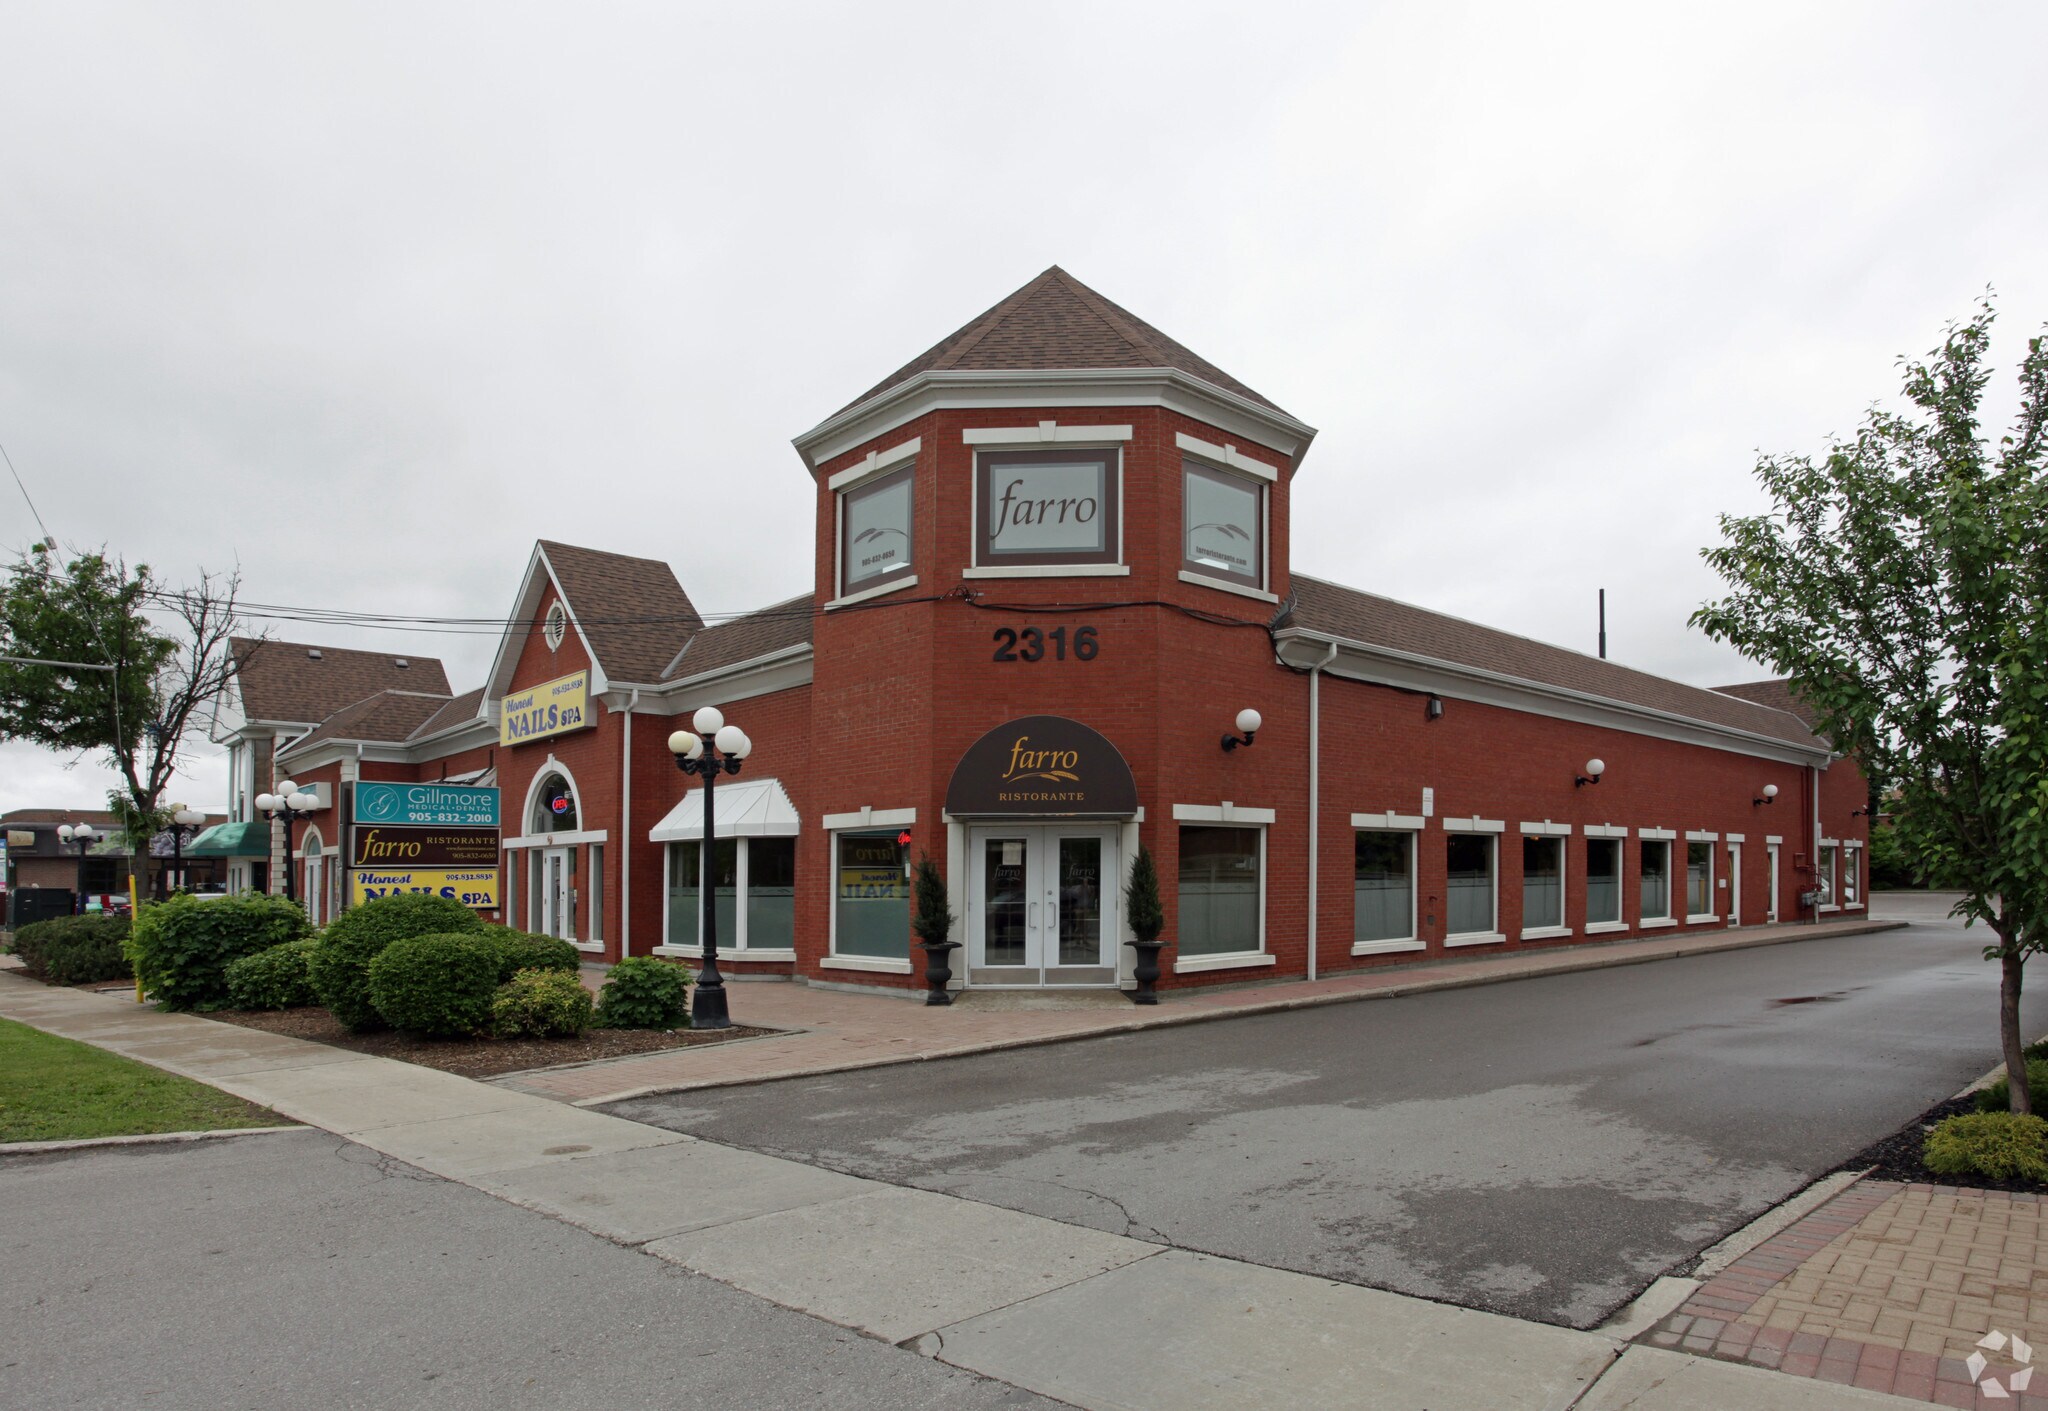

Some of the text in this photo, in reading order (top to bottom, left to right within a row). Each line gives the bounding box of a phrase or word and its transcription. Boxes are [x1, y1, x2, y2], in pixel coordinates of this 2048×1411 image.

[989, 479, 1096, 541] farro
[993, 626, 1099, 662] 2316
[505, 694, 533, 713] Honest
[507, 703, 582, 740] NAILS SPA
[1002, 736, 1079, 779] farro
[407, 787, 492, 806] Gillmore
[999, 792, 1085, 801] RISTORANTE
[408, 812, 492, 823] 905-832-2010
[357, 829, 421, 865] farro
[426, 836, 496, 845] RISTORANTE
[357, 872, 412, 884] Honest
[445, 873, 493, 881] 905.832.8838
[993, 864, 1021, 880] farro
[1066, 863, 1095, 880] farro
[461, 892, 493, 905] SPA
